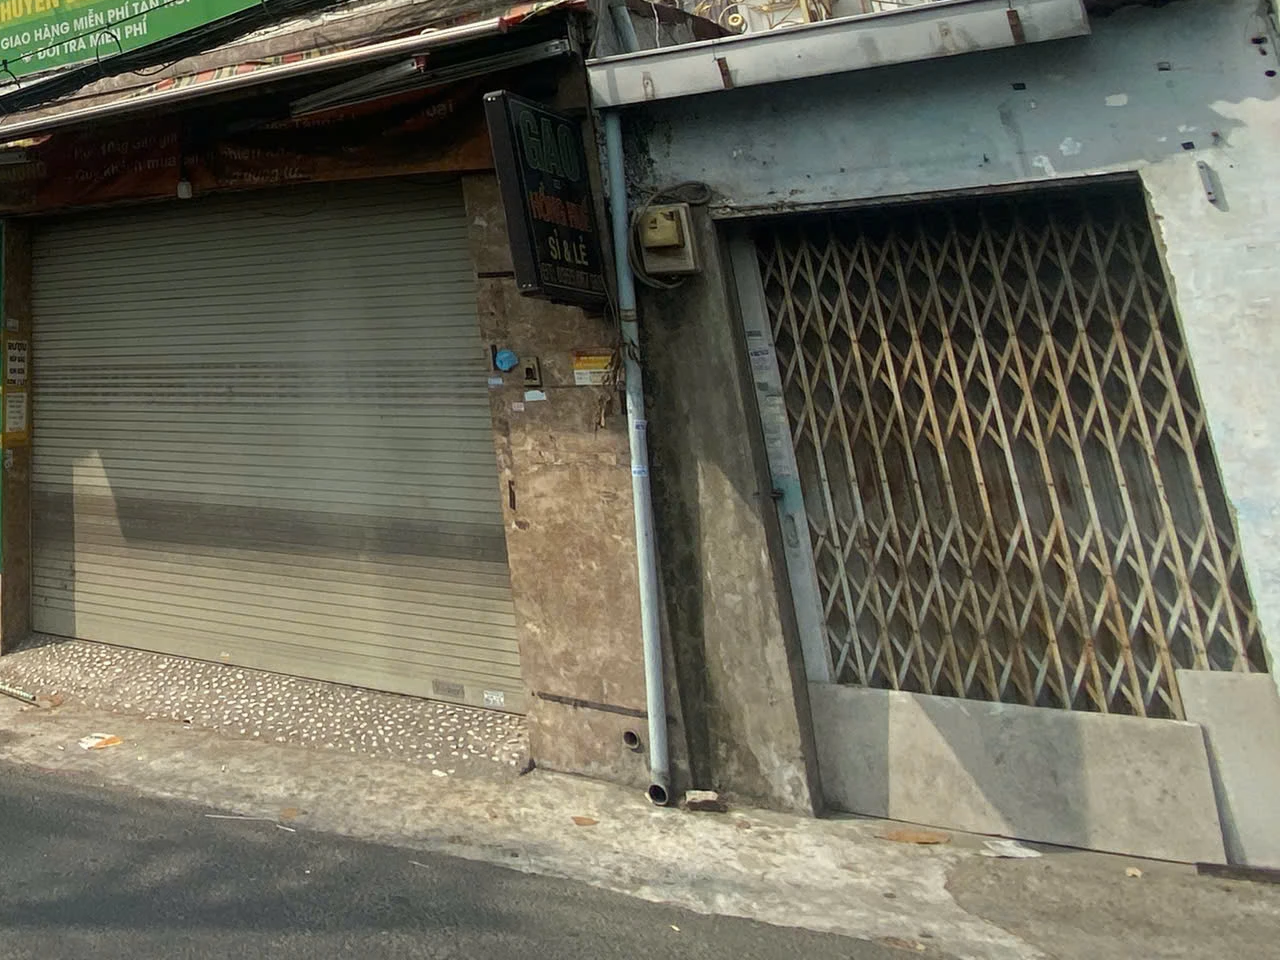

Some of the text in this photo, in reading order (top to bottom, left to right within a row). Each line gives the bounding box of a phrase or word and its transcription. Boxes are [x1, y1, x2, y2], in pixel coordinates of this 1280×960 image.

[0, 31, 31, 51] GIAO
[34, 22, 71, 43] HÀNG
[73, 8, 105, 32] MIỄN
[107, 1, 129, 24] PHÍ
